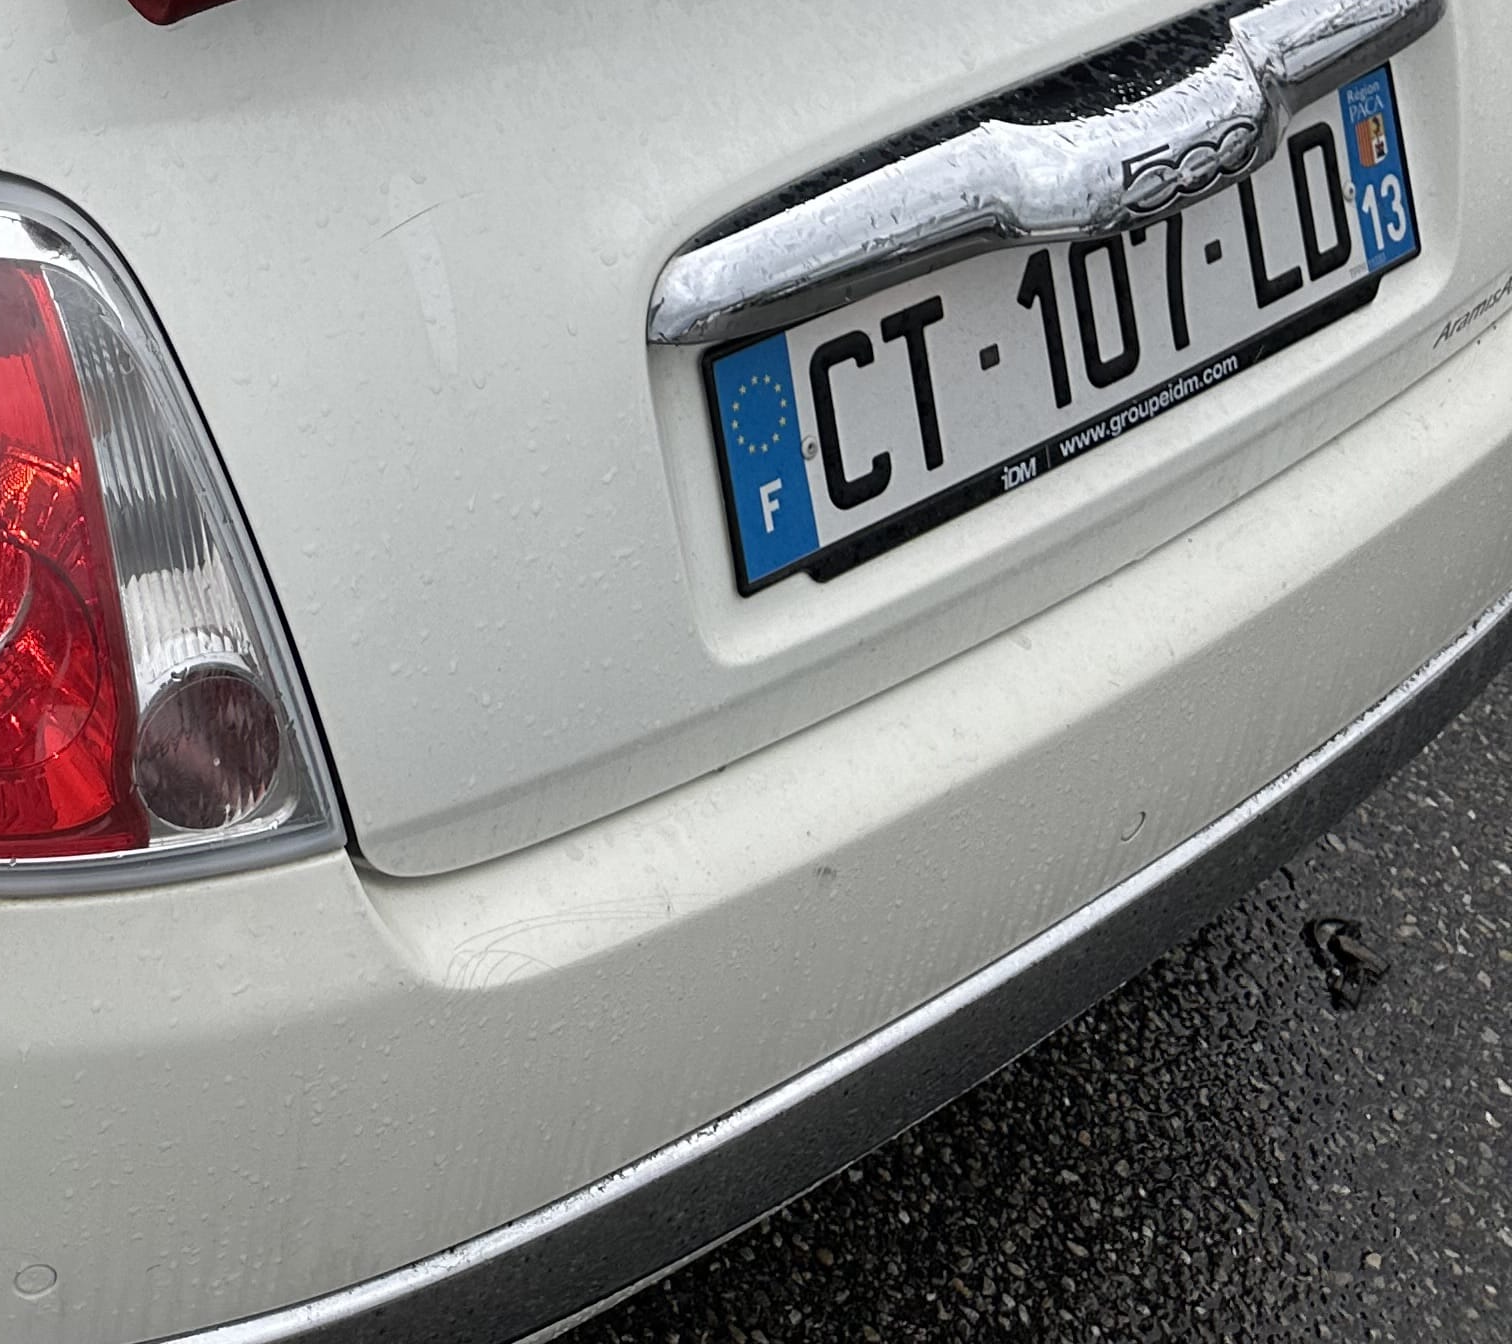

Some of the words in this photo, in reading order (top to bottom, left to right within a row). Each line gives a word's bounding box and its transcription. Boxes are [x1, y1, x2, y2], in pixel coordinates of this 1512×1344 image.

[1348, 94, 1384, 123] PACA
[1121, 121, 1259, 215] 500
[1361, 173, 1407, 251] 13
[1059, 353, 1239, 458] www.groupeidm.com
[759, 477, 782, 534] F
